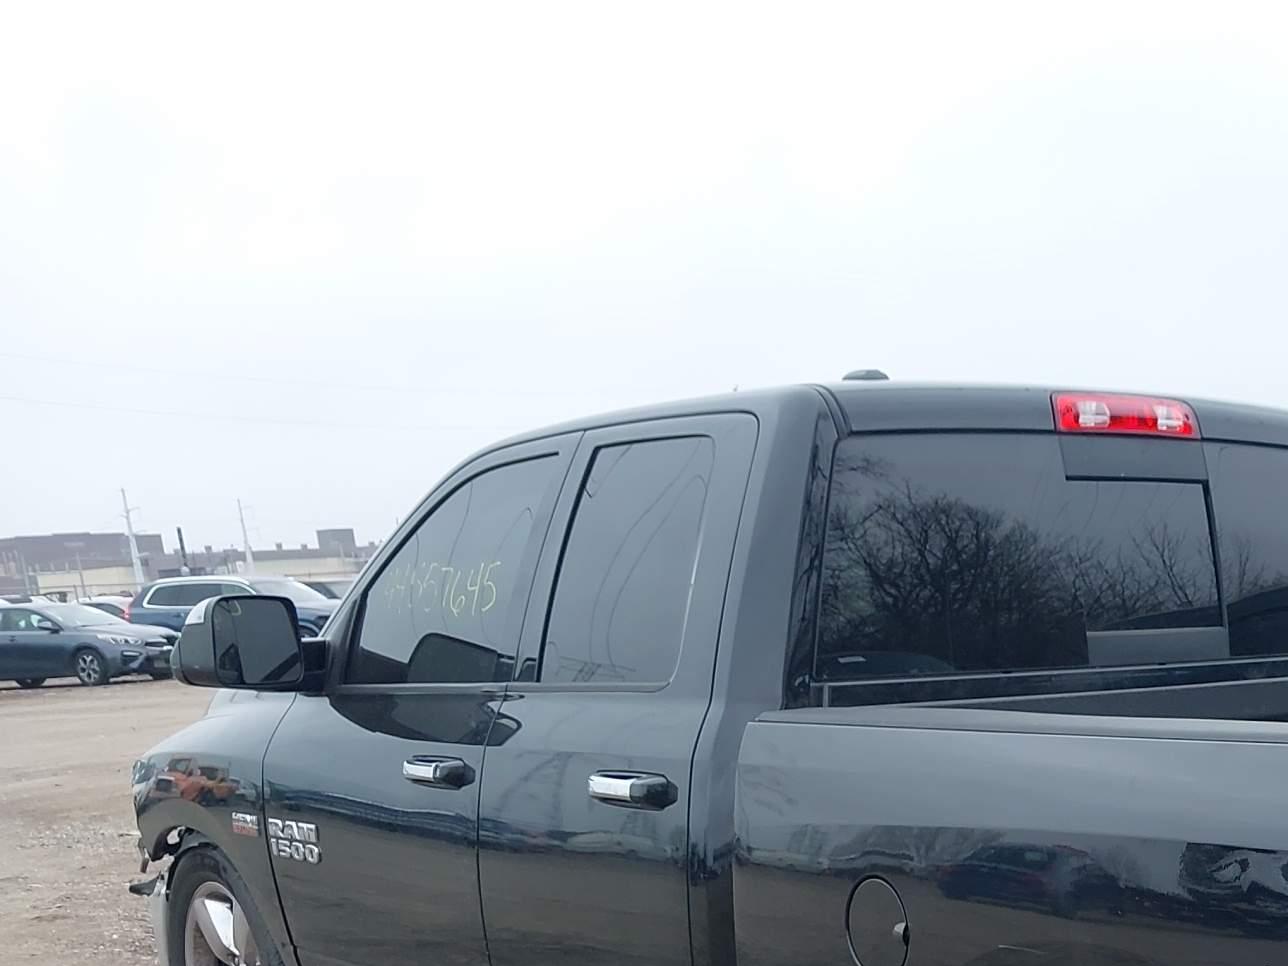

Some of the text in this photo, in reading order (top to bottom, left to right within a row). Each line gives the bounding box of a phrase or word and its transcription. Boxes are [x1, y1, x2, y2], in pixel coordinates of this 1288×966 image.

[384, 561, 502, 617] 557645
[267, 817, 318, 843] RAM
[270, 838, 321, 865] 1500
